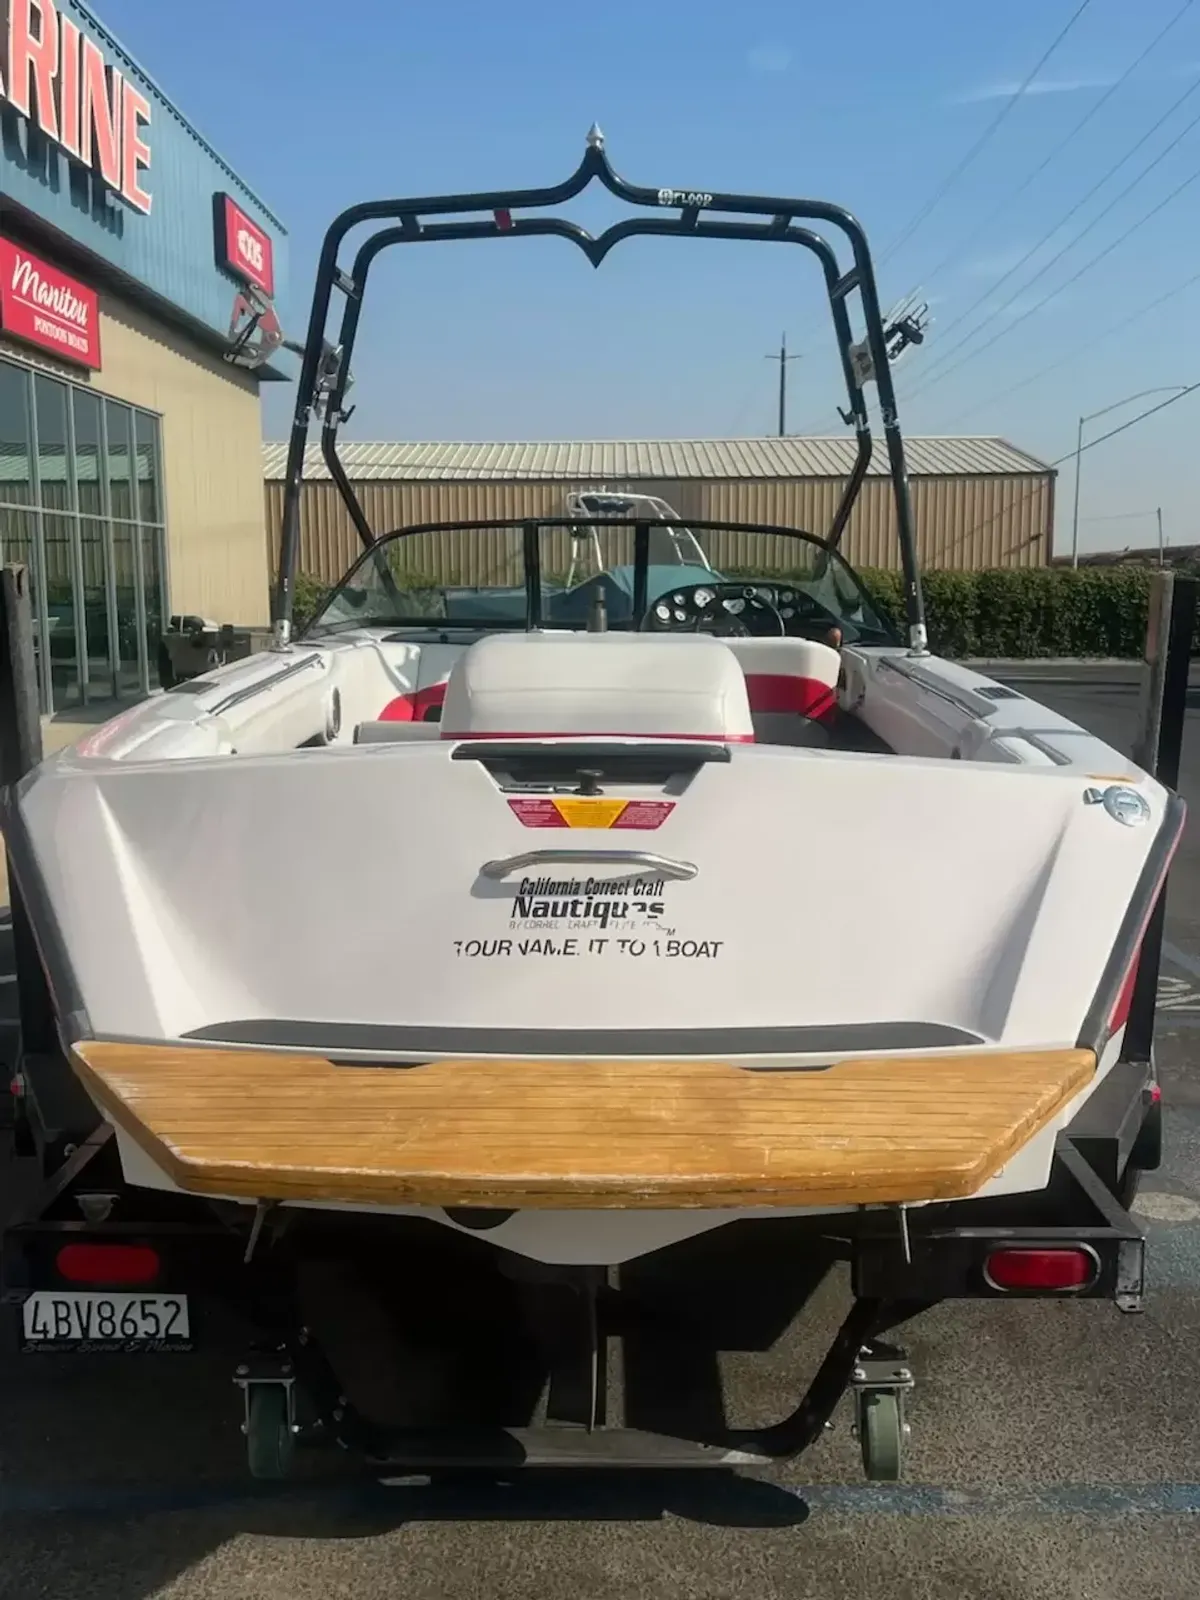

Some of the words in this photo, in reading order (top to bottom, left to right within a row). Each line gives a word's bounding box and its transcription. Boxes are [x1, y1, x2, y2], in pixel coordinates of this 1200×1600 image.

[0, 0, 151, 216] RINE
[12, 254, 88, 327] Manitou
[519, 877, 581, 896] California
[584, 878, 629, 896] Correct
[633, 878, 665, 897] Craft
[31, 1300, 184, 1340] 4BV8652
